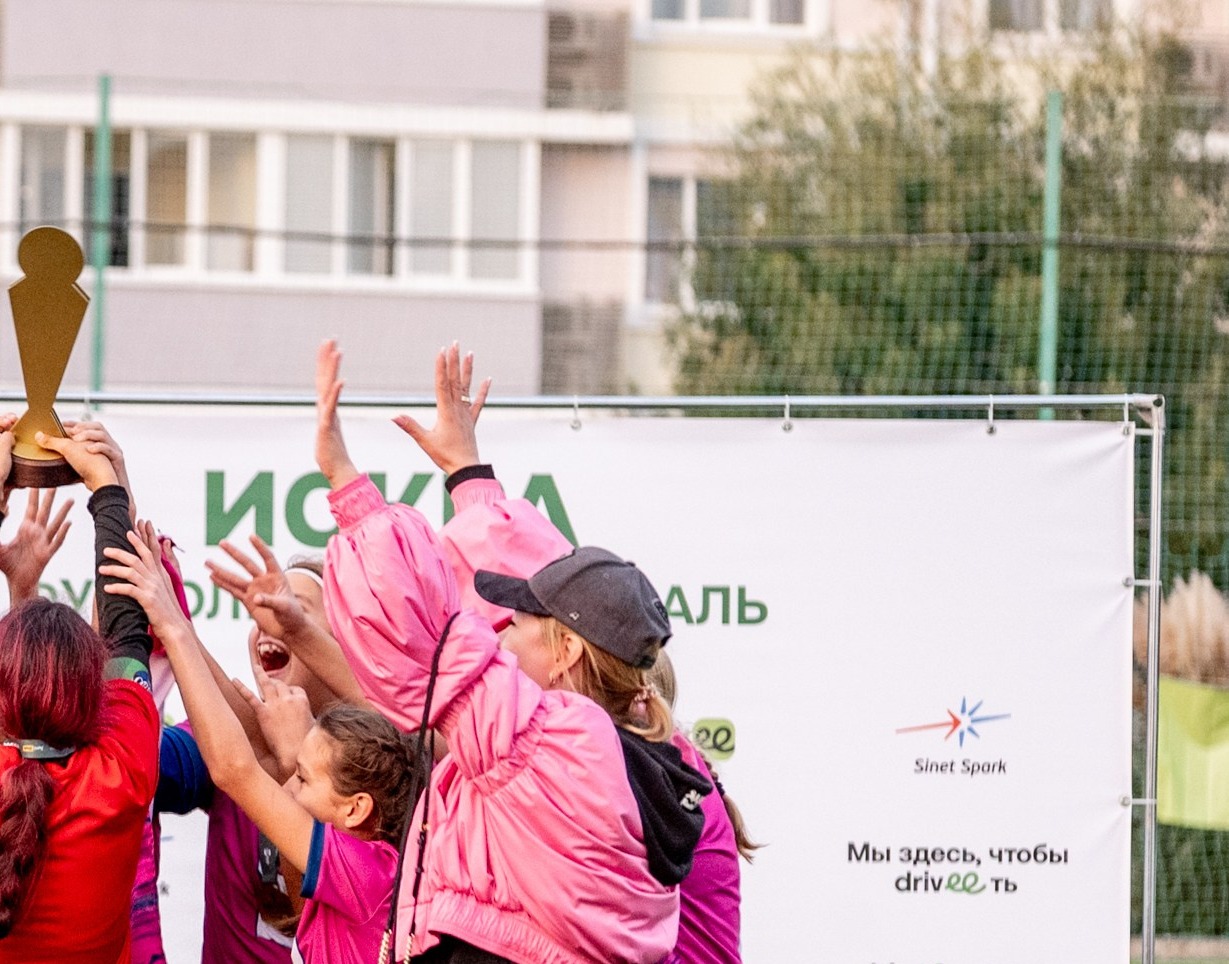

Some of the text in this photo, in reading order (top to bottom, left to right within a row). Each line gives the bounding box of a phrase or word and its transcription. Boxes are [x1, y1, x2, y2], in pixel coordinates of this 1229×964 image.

[913, 758, 1007, 778] Sinet Spark
[846, 842, 1069, 867] Мы здесь, чтобы
